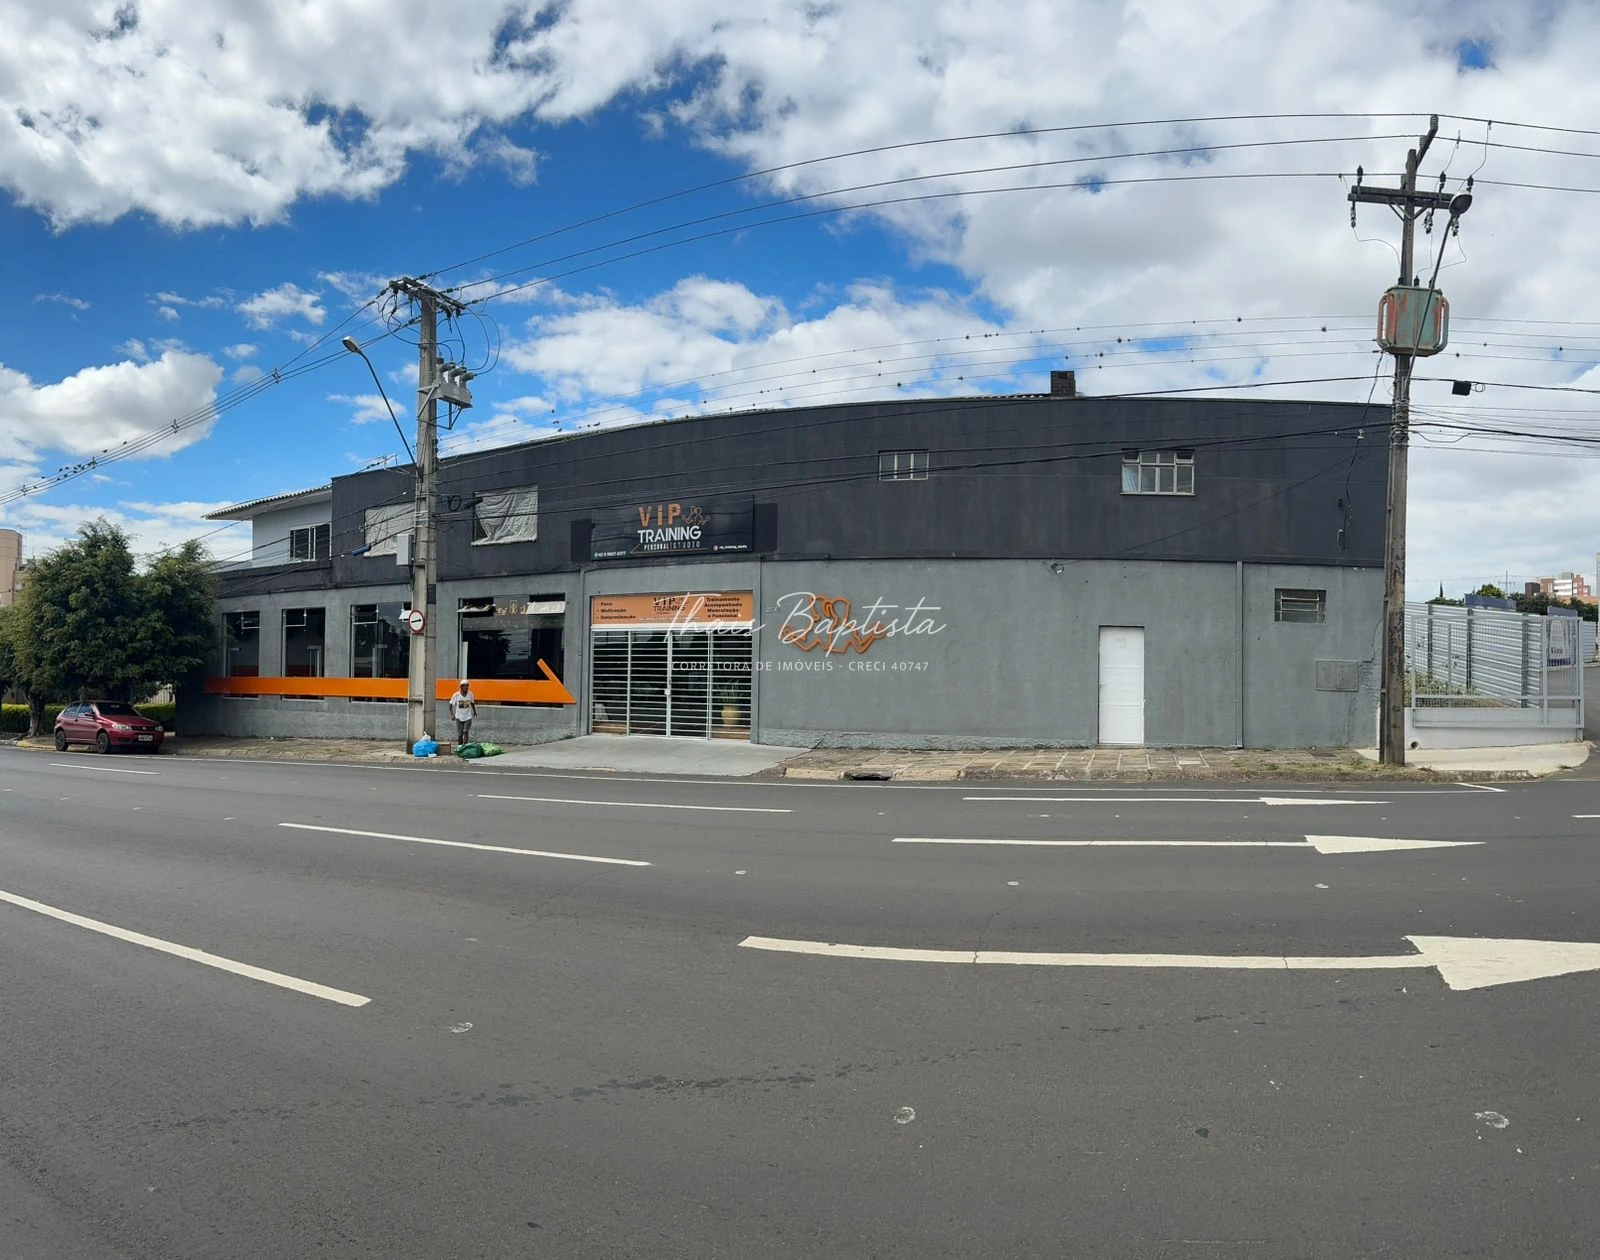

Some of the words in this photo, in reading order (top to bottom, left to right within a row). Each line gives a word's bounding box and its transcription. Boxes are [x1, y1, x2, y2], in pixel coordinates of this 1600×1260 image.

[638, 503, 681, 527] VIP
[637, 525, 702, 544] TRAINING
[643, 543, 669, 551] PERSONAL
[673, 541, 701, 549] STUDIO
